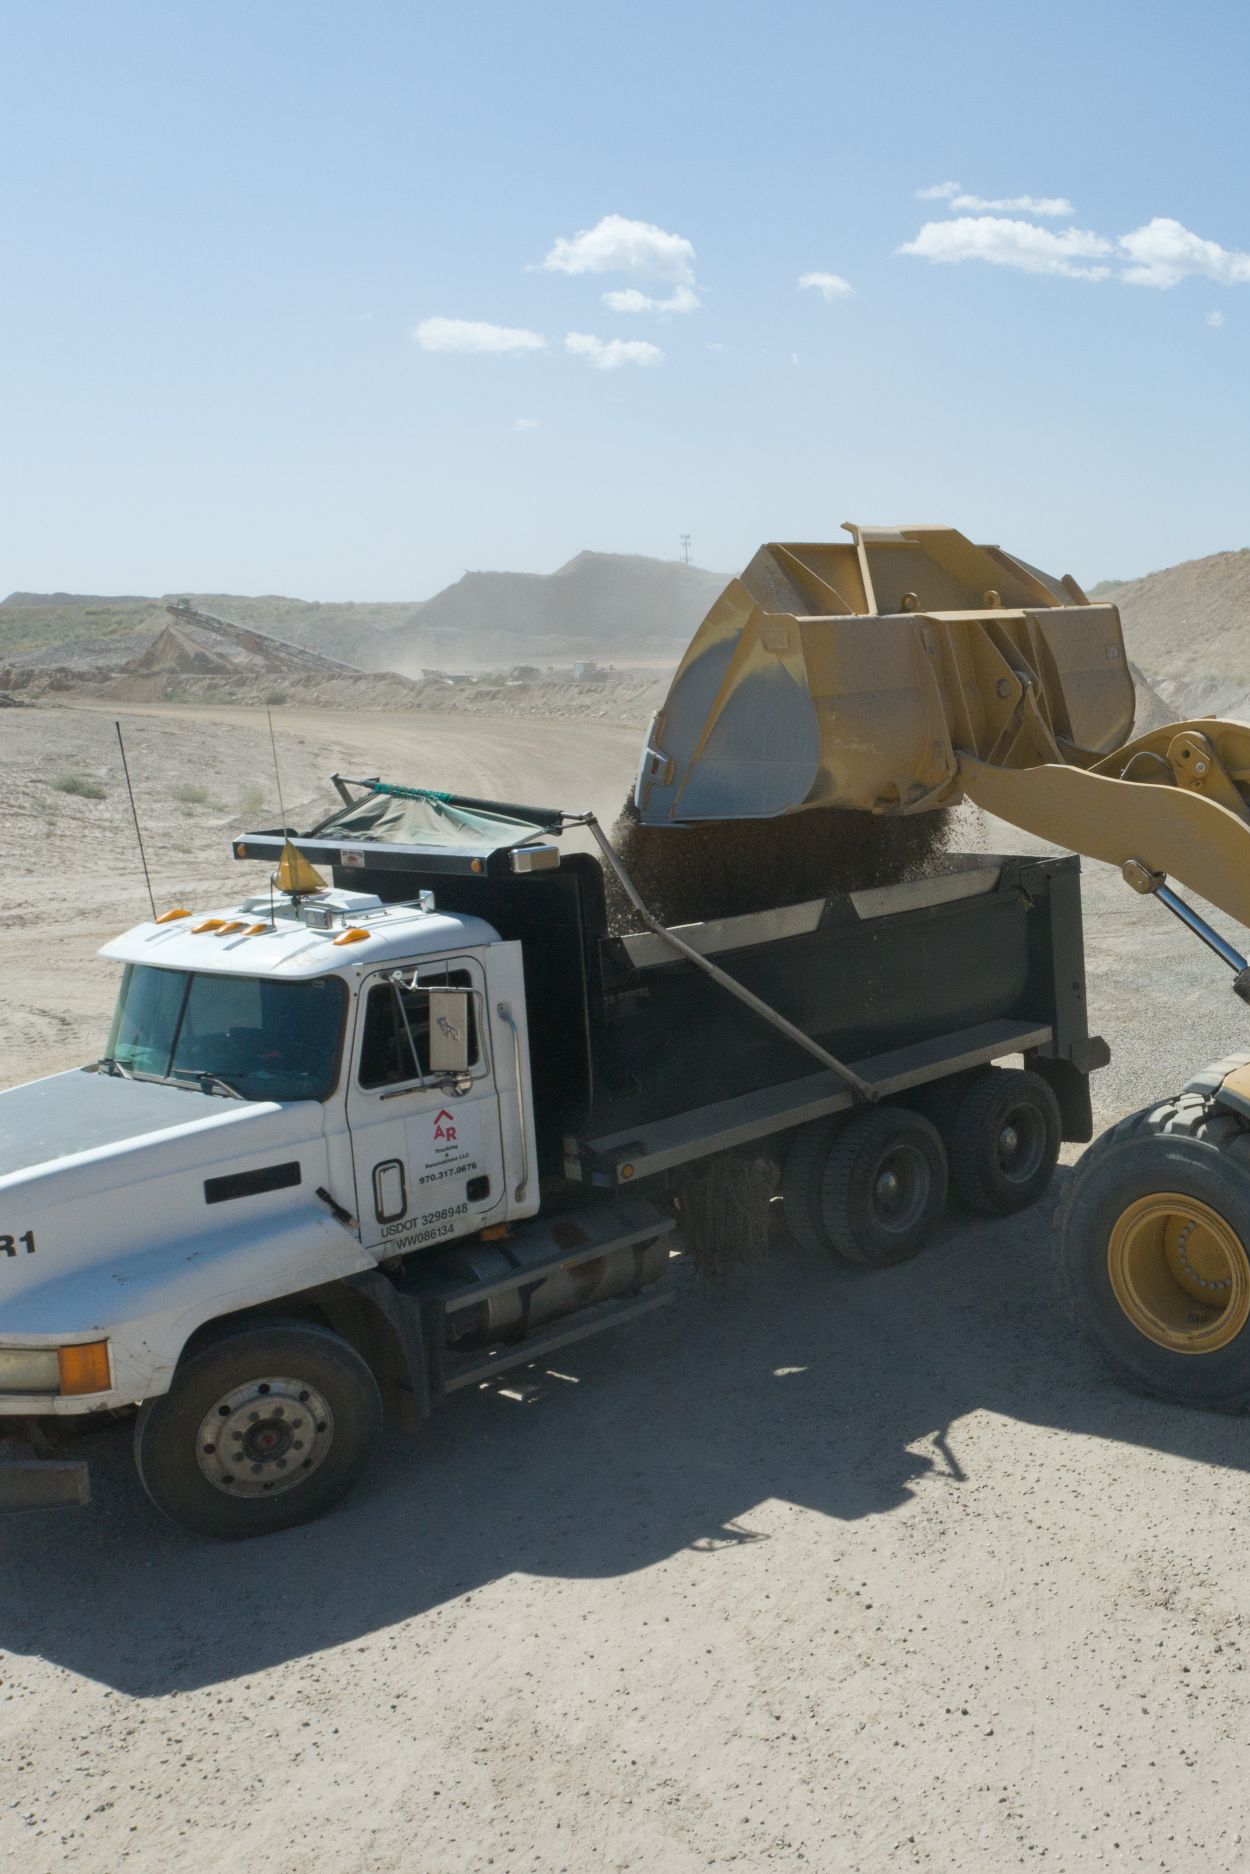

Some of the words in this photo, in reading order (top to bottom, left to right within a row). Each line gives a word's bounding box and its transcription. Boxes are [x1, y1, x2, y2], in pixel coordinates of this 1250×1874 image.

[434, 1124, 457, 1141] AR
[459, 1152, 470, 1160] LLC
[381, 1216, 418, 1238] USDOT
[421, 1202, 468, 1226] 3298948
[396, 1223, 454, 1249] WW086134
